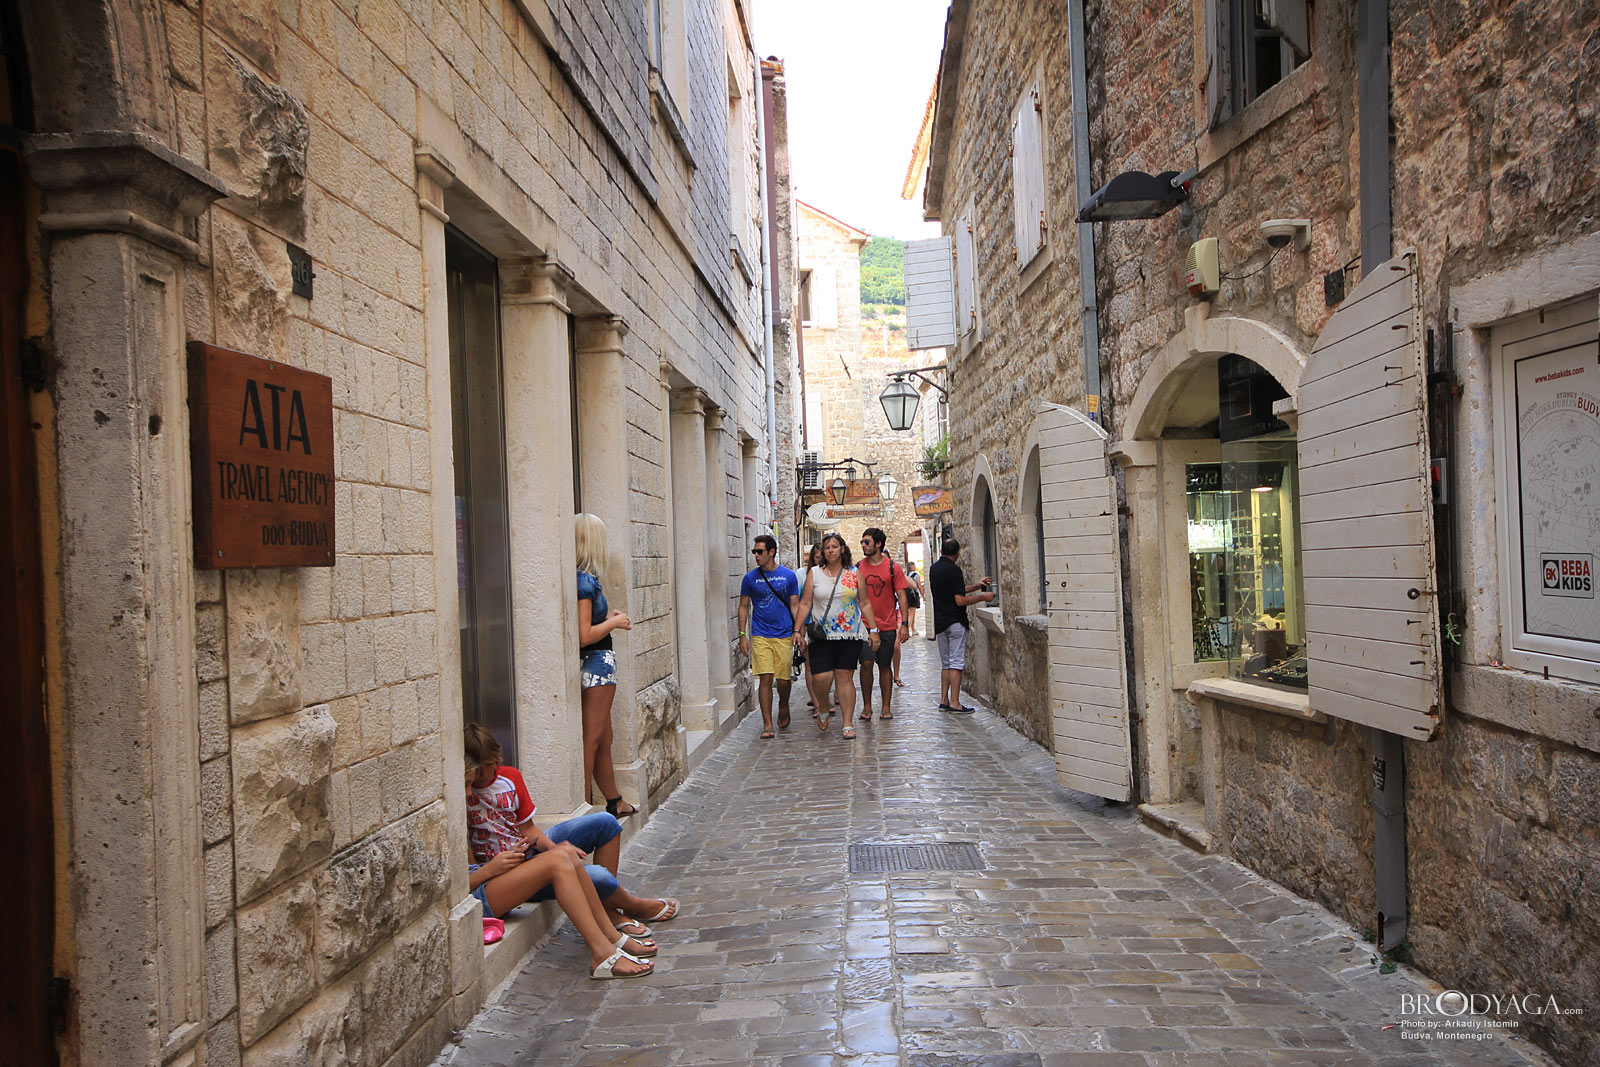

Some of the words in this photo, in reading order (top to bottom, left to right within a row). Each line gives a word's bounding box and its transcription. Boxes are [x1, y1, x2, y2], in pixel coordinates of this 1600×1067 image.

[295, 260, 309, 284] 16
[1534, 367, 1585, 383] www.bebakids.com
[239, 378, 312, 455] ATA
[1577, 397, 1600, 418] BUDV
[217, 461, 274, 503] TRAVEL
[278, 468, 331, 507] AGENCY
[290, 520, 329, 547] BUDVA
[1545, 568, 1557, 581] BK
[1561, 560, 1591, 577] BEBA
[1562, 576, 1591, 592] KIDS
